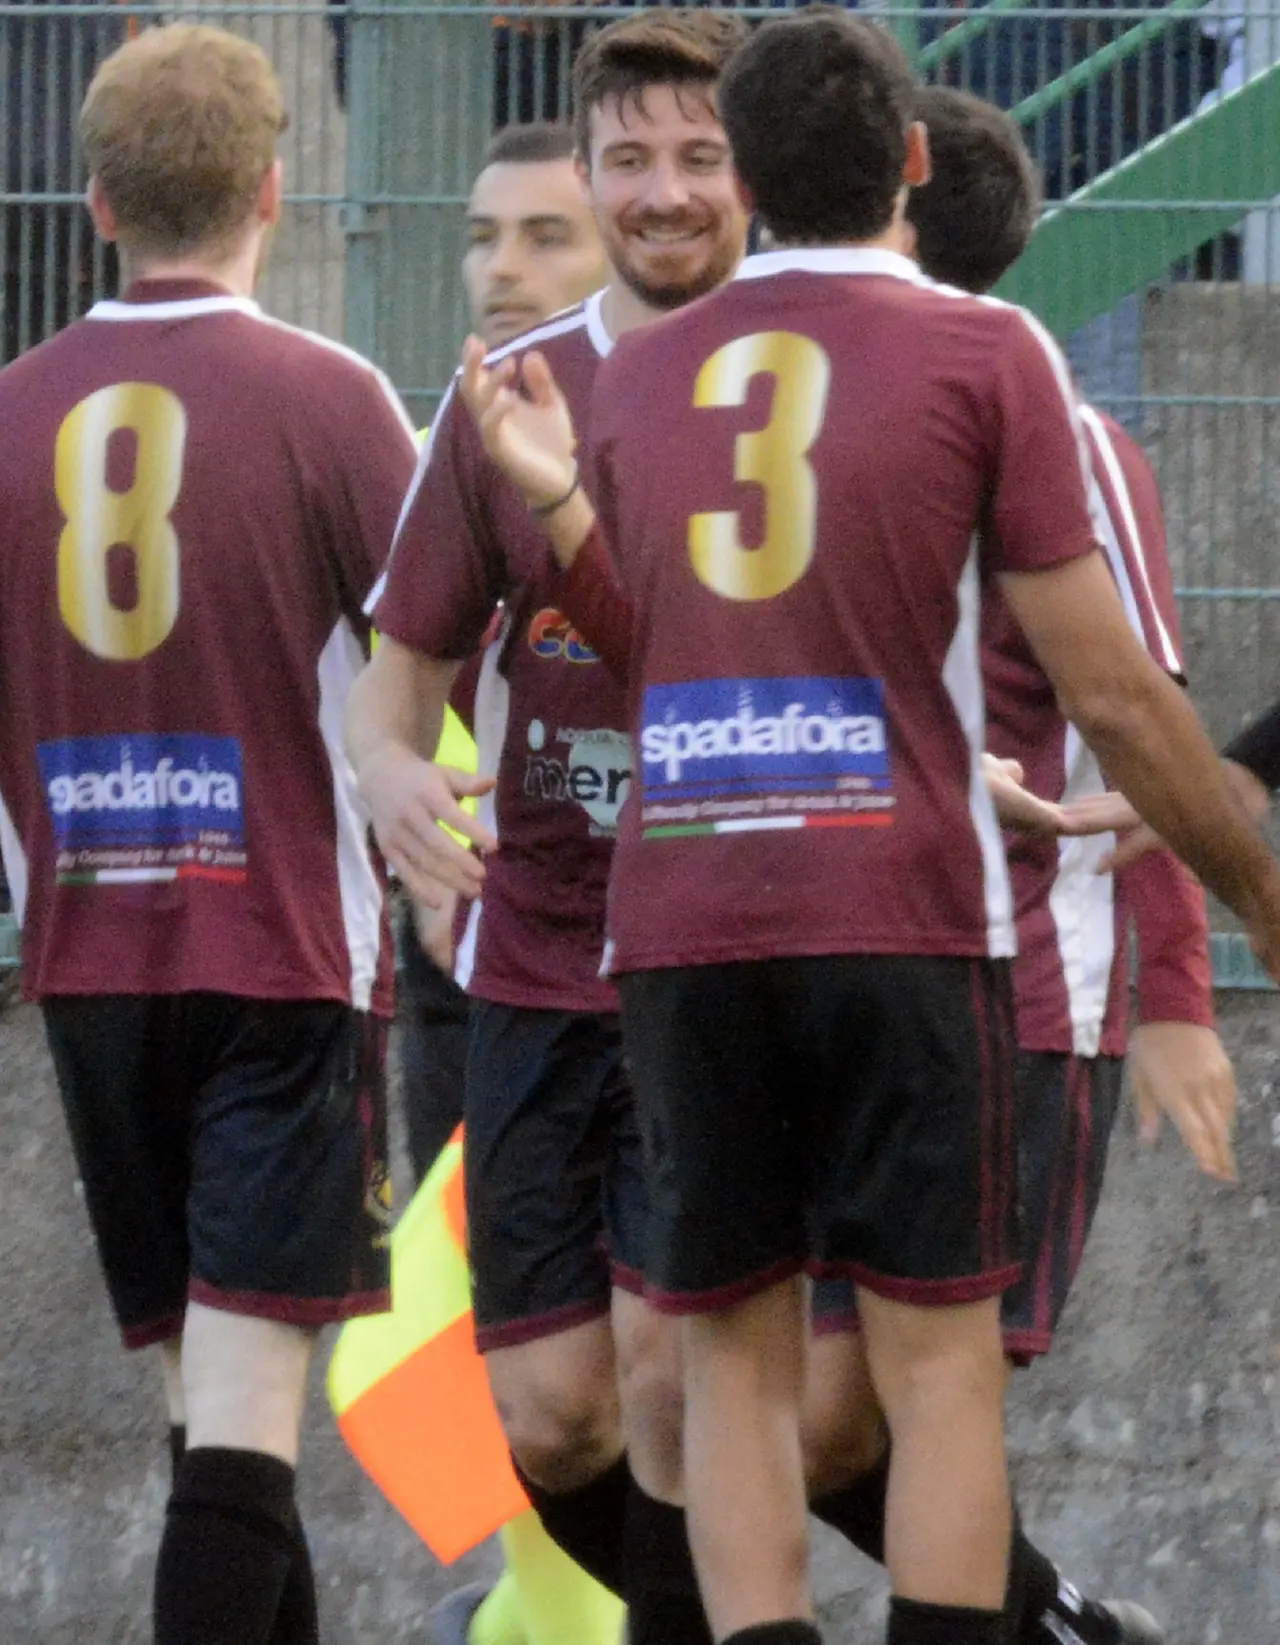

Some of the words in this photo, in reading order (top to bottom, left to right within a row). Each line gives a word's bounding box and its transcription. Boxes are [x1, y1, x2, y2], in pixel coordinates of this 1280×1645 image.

[55, 381, 188, 662] 8
[688, 331, 831, 600] 3
[641, 699, 886, 782] spadafora
